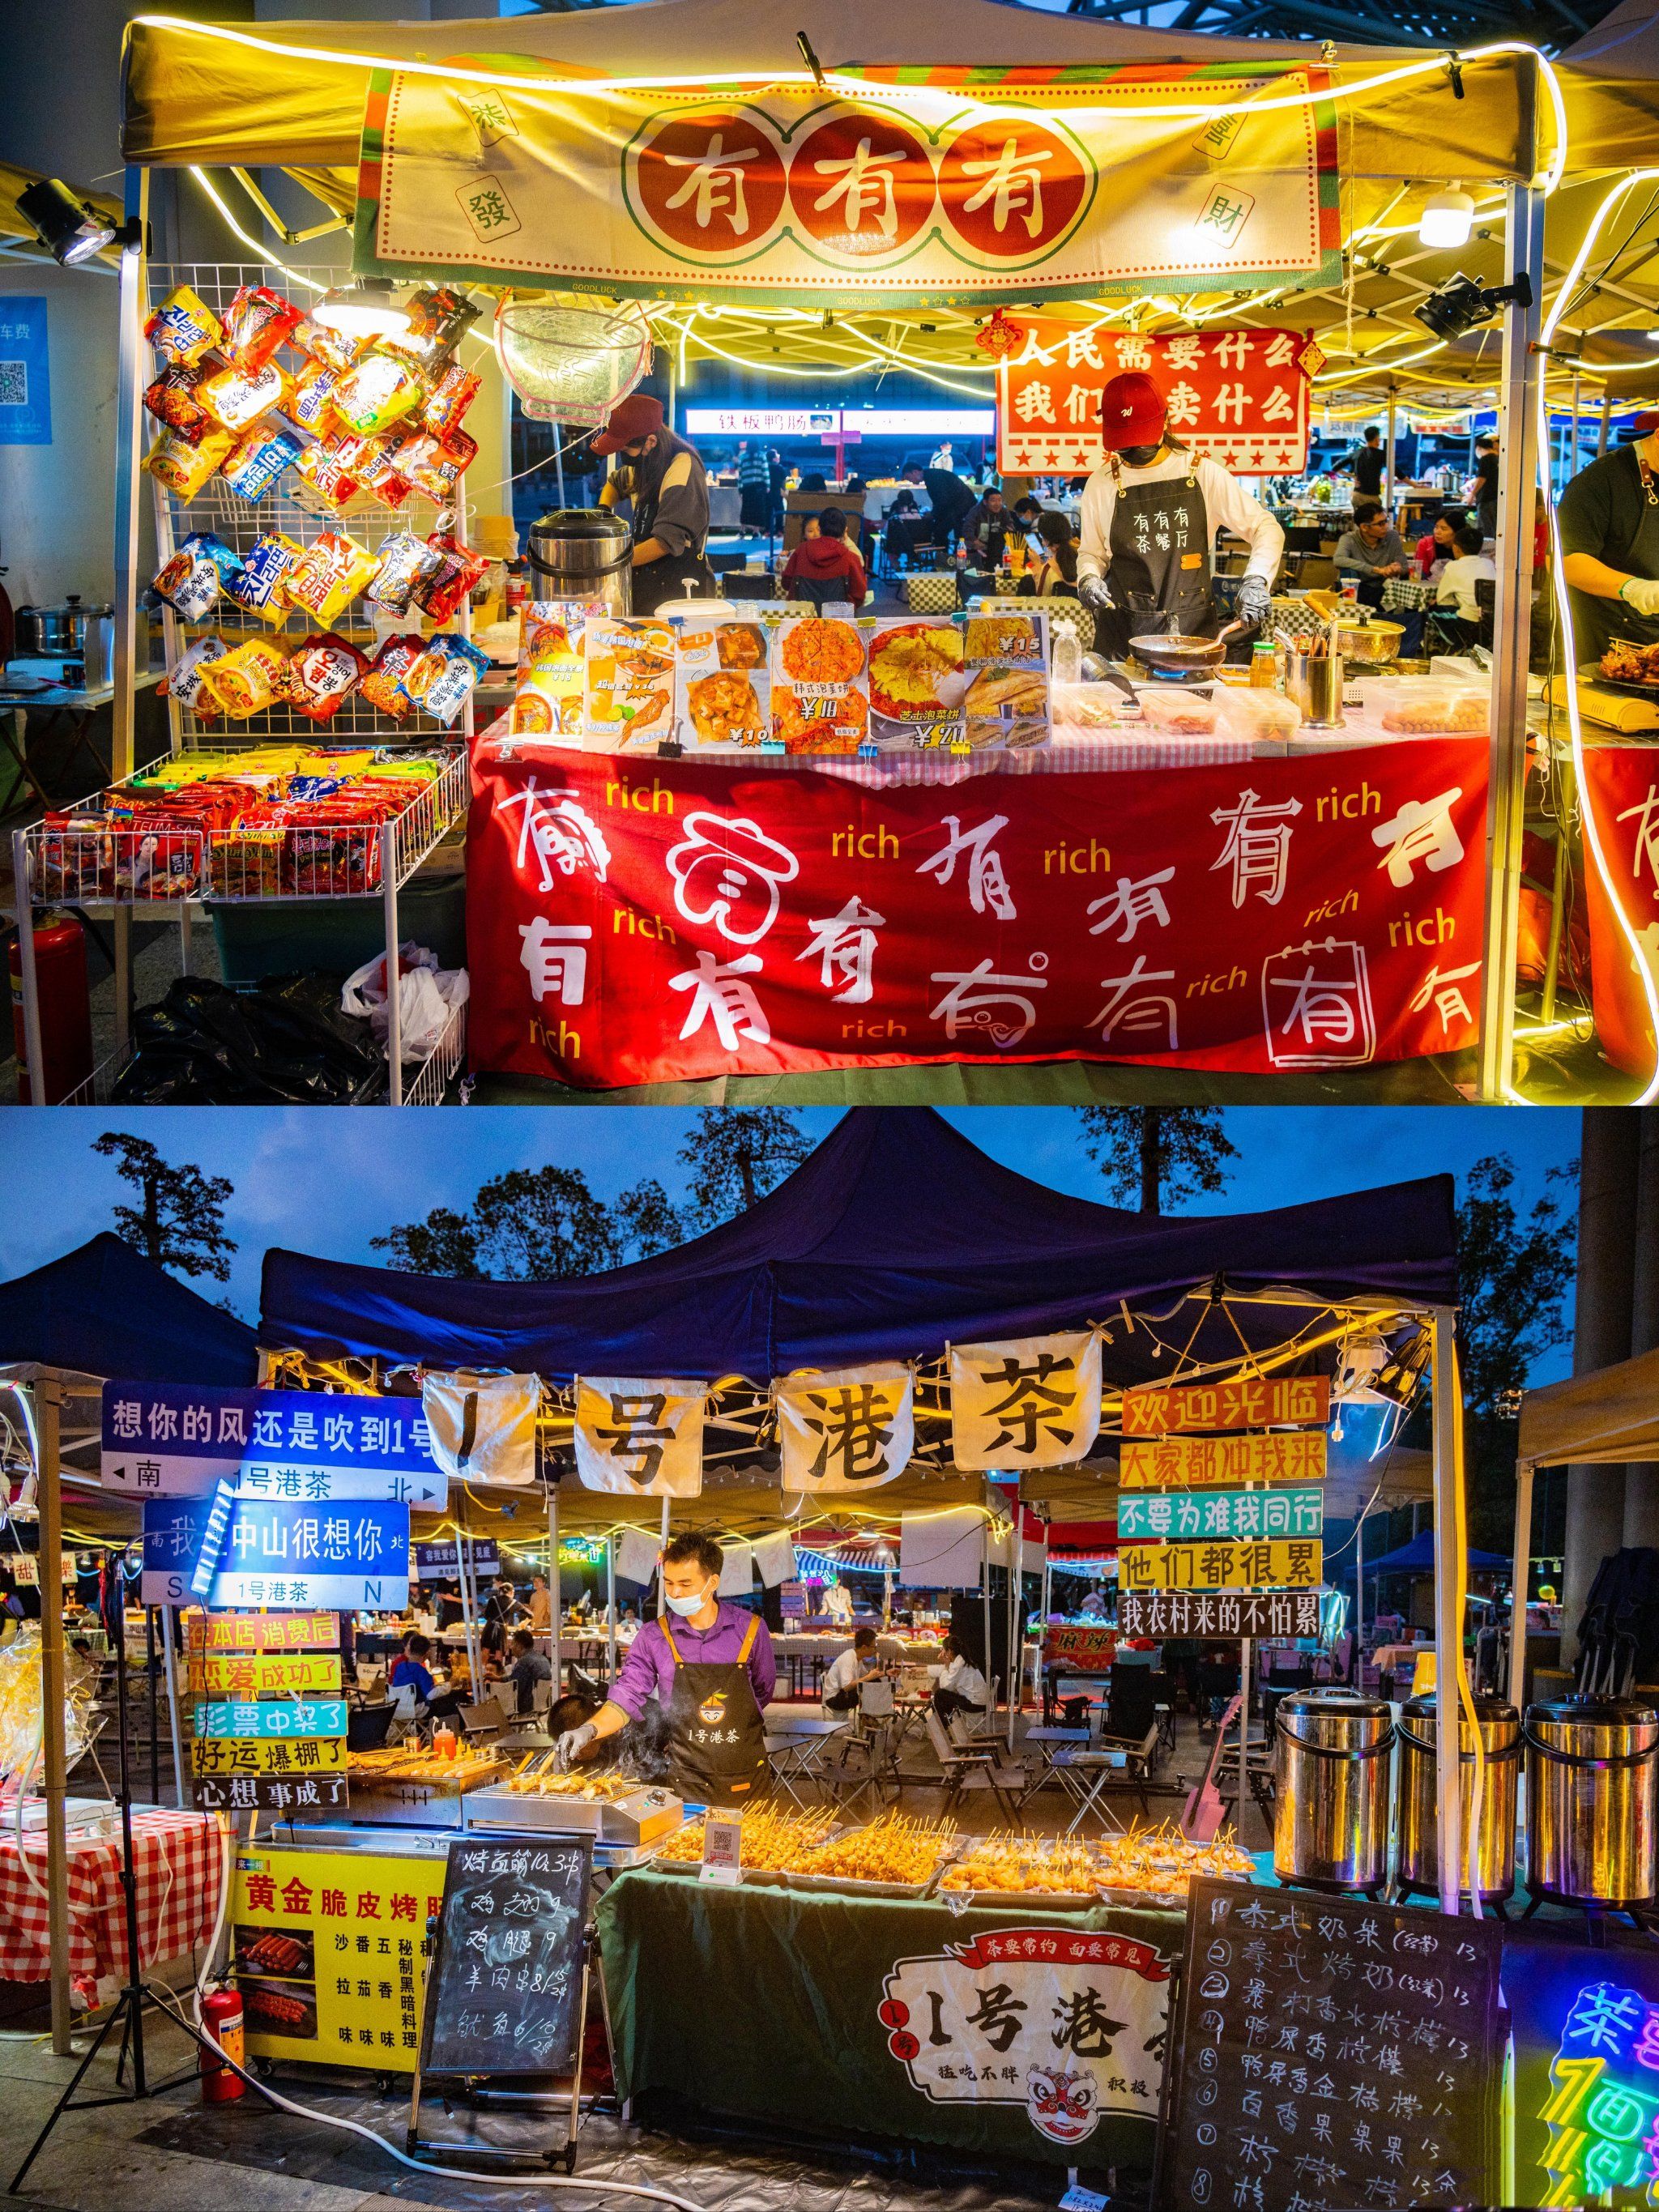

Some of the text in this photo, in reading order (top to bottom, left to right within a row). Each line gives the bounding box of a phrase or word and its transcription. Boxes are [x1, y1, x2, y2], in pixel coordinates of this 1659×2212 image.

[665, 134, 1053, 238] 有有有
[469, 191, 511, 228] 發
[1202, 196, 1243, 236] 財
[573, 283, 617, 295] GOODLUCK
[838, 296, 882, 306] GOODLUCK
[1099, 284, 1143, 296] GOODLUCK
[1020, 328, 1296, 371] 人民需要什么
[719, 414, 806, 431] 铁板鸭肠
[1014, 381, 1294, 426] 我们卖什么
[1133, 506, 1189, 534] 有有有
[1136, 530, 1189, 553] 茶餐厅
[999, 637, 1040, 651] ¥15
[430, 664, 468, 707] 安城湯麵
[794, 683, 849, 694] 韩式泡菜饼
[730, 728, 769, 741] ¥10
[900, 710, 960, 721] 芝士泡菜饼
[607, 776, 675, 814] rich
[1316, 782, 1382, 823] rich
[832, 824, 899, 859] rich
[1043, 838, 1111, 875] rich
[1208, 788, 1303, 909] 有
[915, 814, 1017, 921] 有
[1086, 866, 1175, 943] 有
[1303, 889, 1358, 929] rich
[614, 906, 676, 945] rich
[1388, 907, 1456, 948] rich
[518, 916, 592, 1005] 有
[795, 895, 885, 1004] 有
[667, 950, 771, 1051] 有
[1186, 966, 1247, 999] rich
[1410, 960, 1482, 1034] 有
[1083, 955, 1179, 1051] 有
[1270, 965, 1355, 1044] 有
[530, 1016, 581, 1059] rich
[842, 1020, 907, 1038] rich
[1128, 1381, 1317, 1432] 欢迎光临
[112, 1400, 433, 1459] 想你的风还是吹到1号
[1121, 1436, 1323, 1485] 大家都冲我来
[136, 1460, 162, 1488] 南
[388, 1477, 412, 1503] 北
[1120, 1495, 1321, 1533] 不要为难我同行
[170, 1515, 382, 1562] 我中山很想你
[390, 1534, 404, 1549] 北
[1121, 1543, 1316, 1587] 他们都很累
[168, 1579, 382, 1603] S 1号港茶 N
[190, 1616, 335, 1647] 在本店消费后
[1123, 1596, 1318, 1634] 我农村来的不怕累
[190, 1658, 335, 1690] 恋爱成功了
[198, 1703, 340, 1736] 彩票中奖了
[688, 1729, 740, 1743] 1号港茶
[194, 1738, 341, 1771] 好运爆棚了
[196, 1779, 345, 1809] 心想事成了
[987, 1937, 1141, 1965] 茶要常约 面要常见
[399, 1938, 417, 2048] 秘制黑暗料理
[1570, 1989, 1639, 2053] 茶
[938, 2065, 1019, 2084] 猛吃不胖
